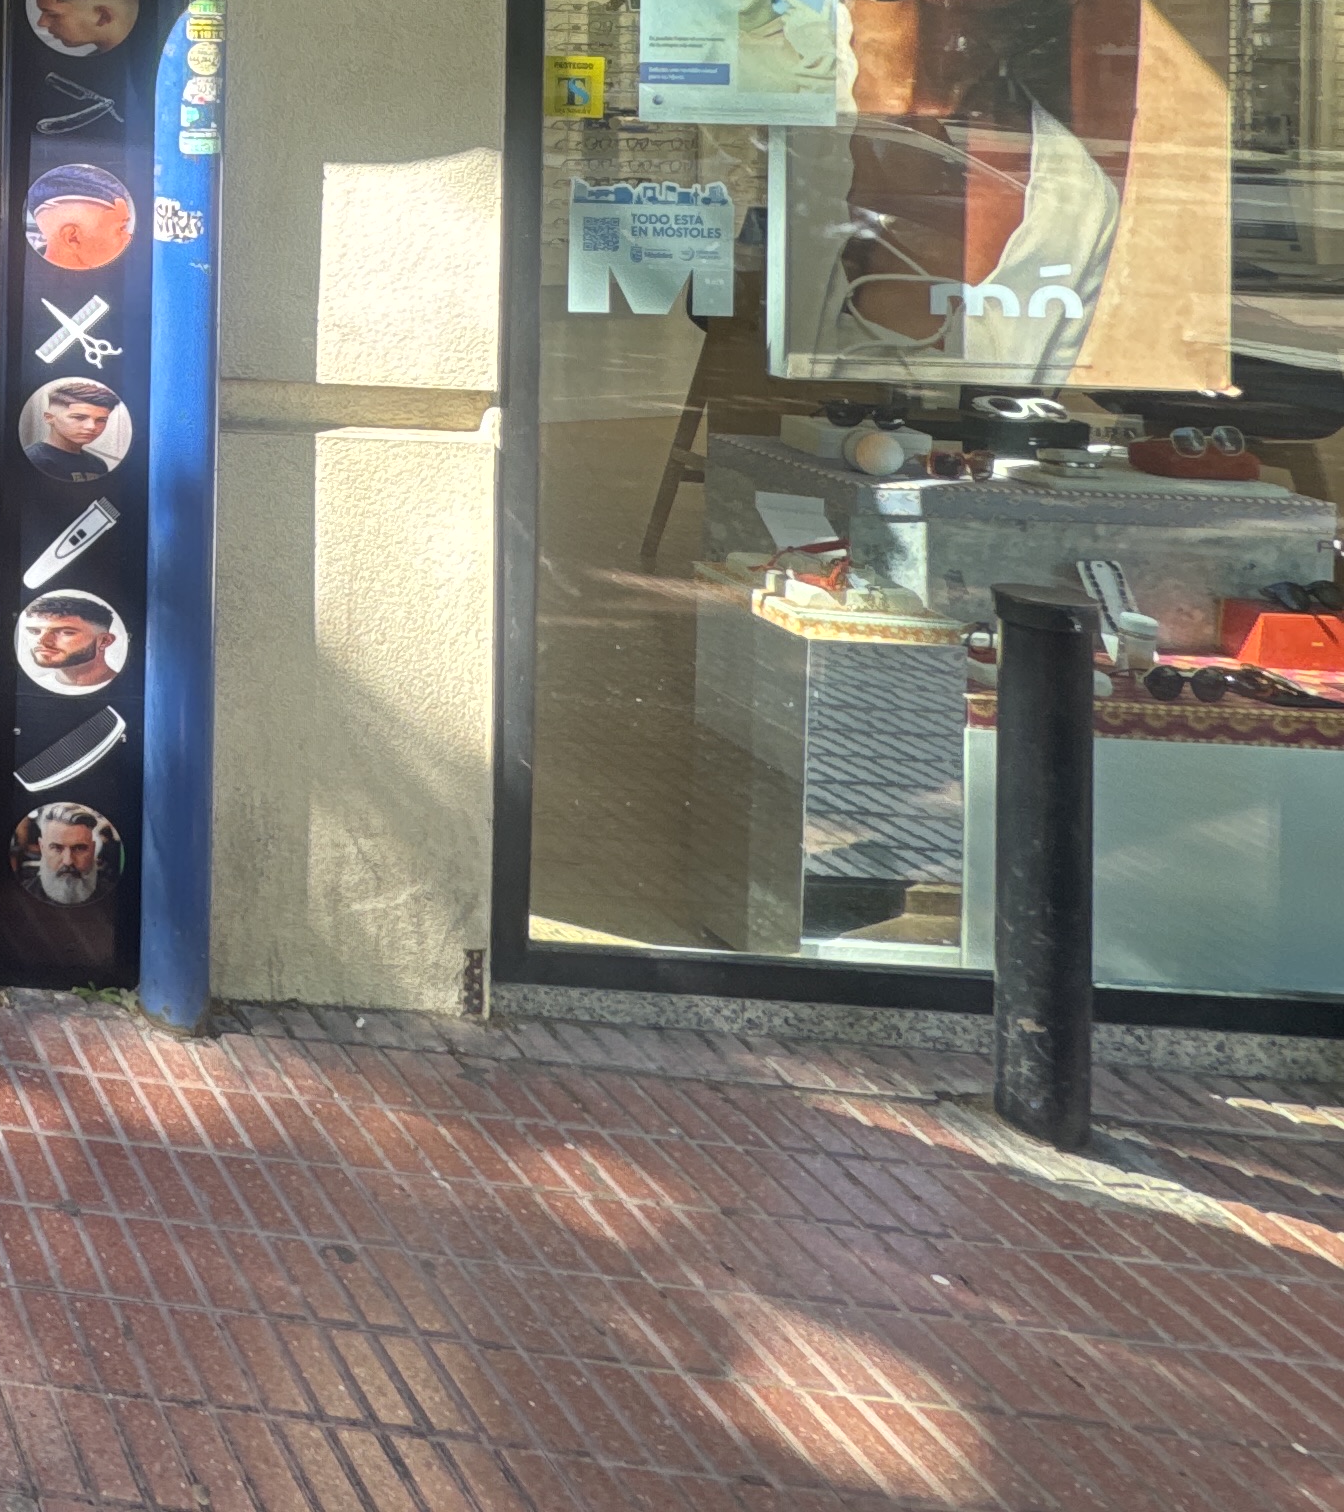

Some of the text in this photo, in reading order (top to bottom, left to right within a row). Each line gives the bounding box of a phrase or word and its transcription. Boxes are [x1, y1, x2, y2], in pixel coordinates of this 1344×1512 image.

[631, 212, 704, 226] TODO ESTÁ
[631, 224, 722, 239] EN MÓSTOLES
